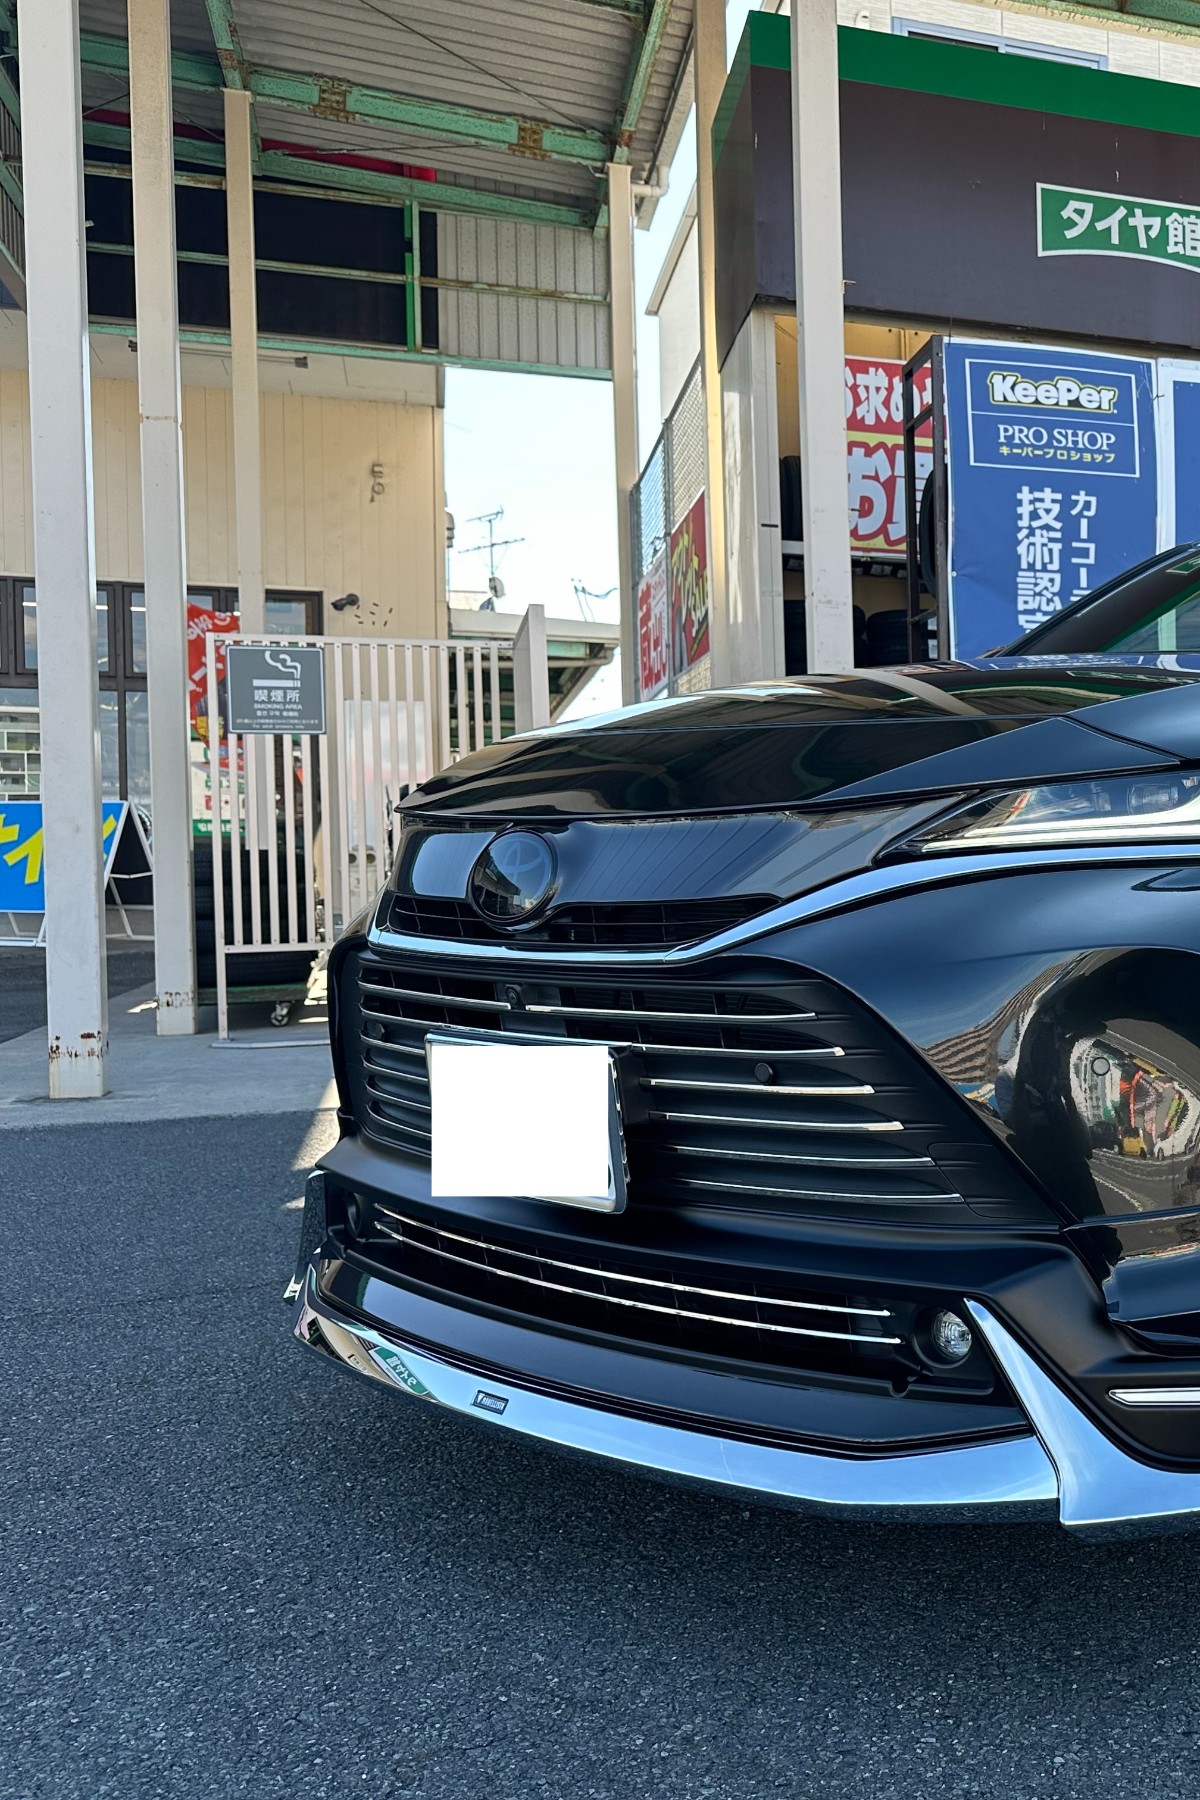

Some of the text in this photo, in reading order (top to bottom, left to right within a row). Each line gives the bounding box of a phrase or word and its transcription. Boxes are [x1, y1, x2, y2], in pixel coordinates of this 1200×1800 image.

[997, 424, 1116, 450] PRO SHOP
[254, 689, 300, 703] 喫煙所
[285, 703, 303, 711] AREA
